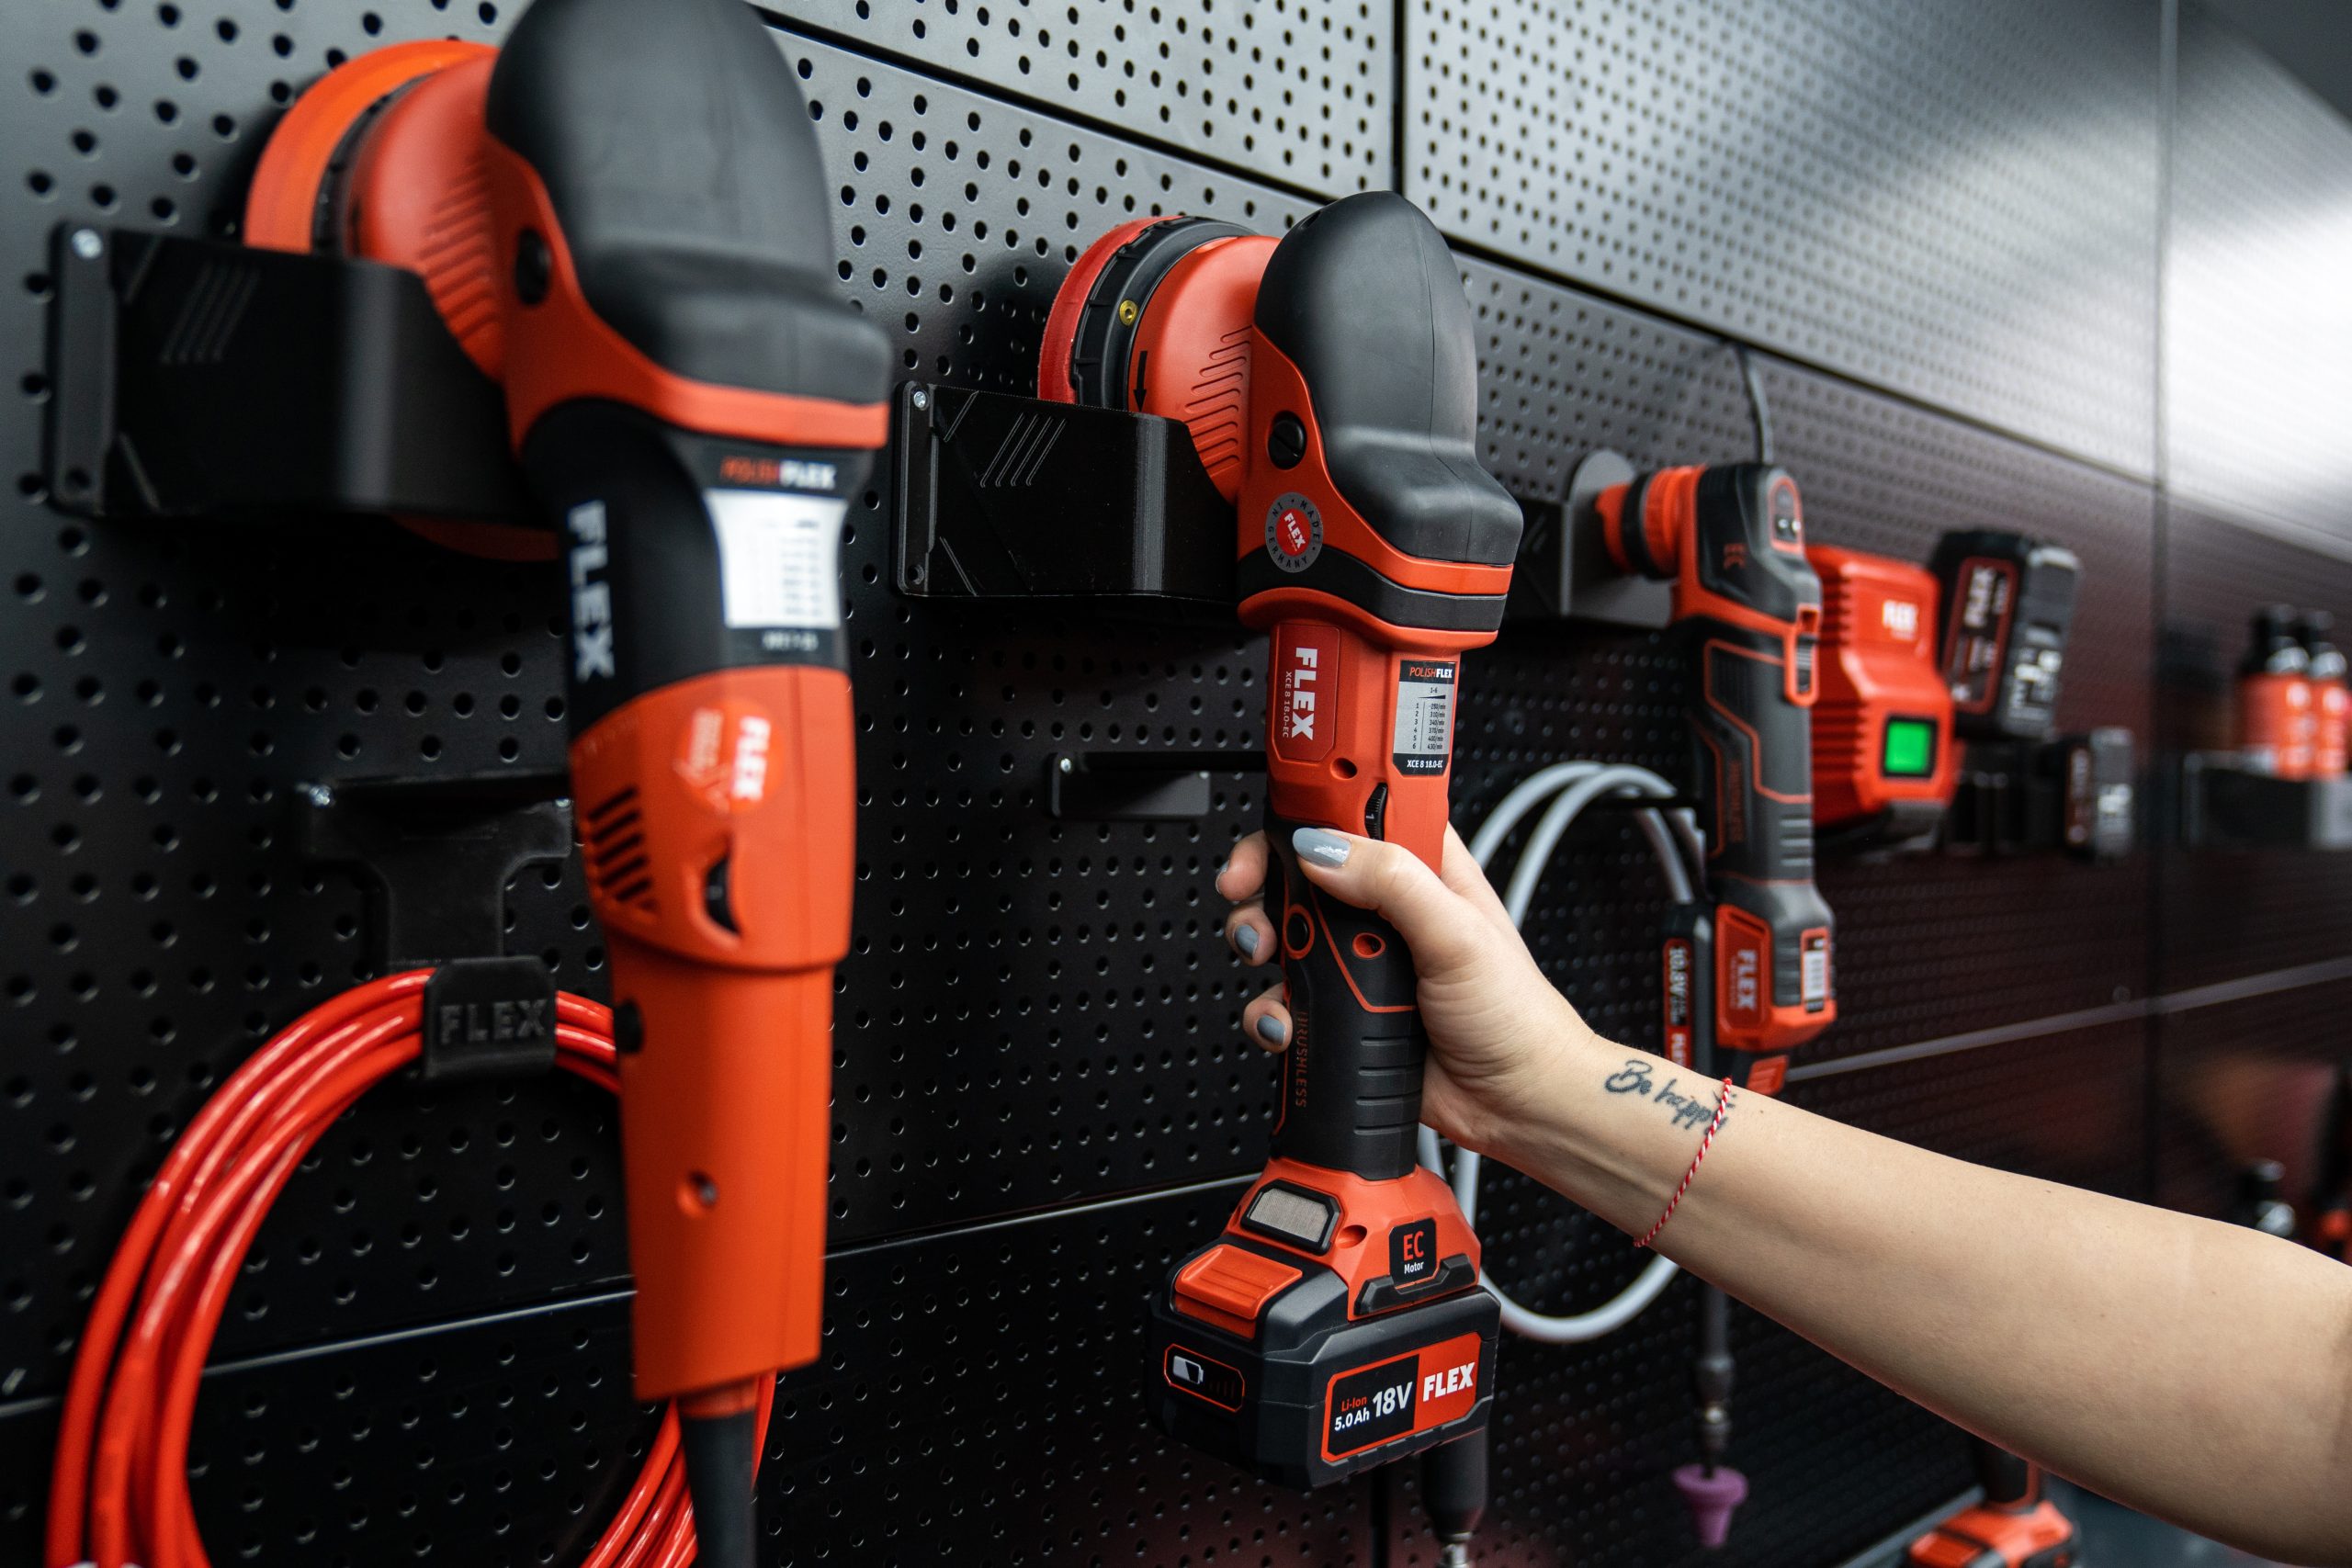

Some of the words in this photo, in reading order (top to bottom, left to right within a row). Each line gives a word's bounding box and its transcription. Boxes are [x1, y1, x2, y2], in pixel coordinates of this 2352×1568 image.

[1283, 512, 1306, 549] FLEX
[1300, 500, 1320, 542] MADE
[1268, 525, 1307, 568] GERMANY
[568, 500, 615, 682] FLEX
[1409, 667, 1453, 678] POLISHFLEX
[1291, 647, 1317, 740] FLEX
[1407, 760, 1419, 768] XCE
[1737, 949, 1758, 1012] FLEX
[440, 998, 547, 1044] FLEX
[1605, 1059, 1653, 1095] Be
[1403, 1231, 1424, 1261] EC
[1404, 1261, 1424, 1275] Motor
[1372, 1381, 1413, 1417] 18V
[1422, 1361, 1475, 1403] FLEX
[1340, 1395, 1367, 1412] Li-Ion
